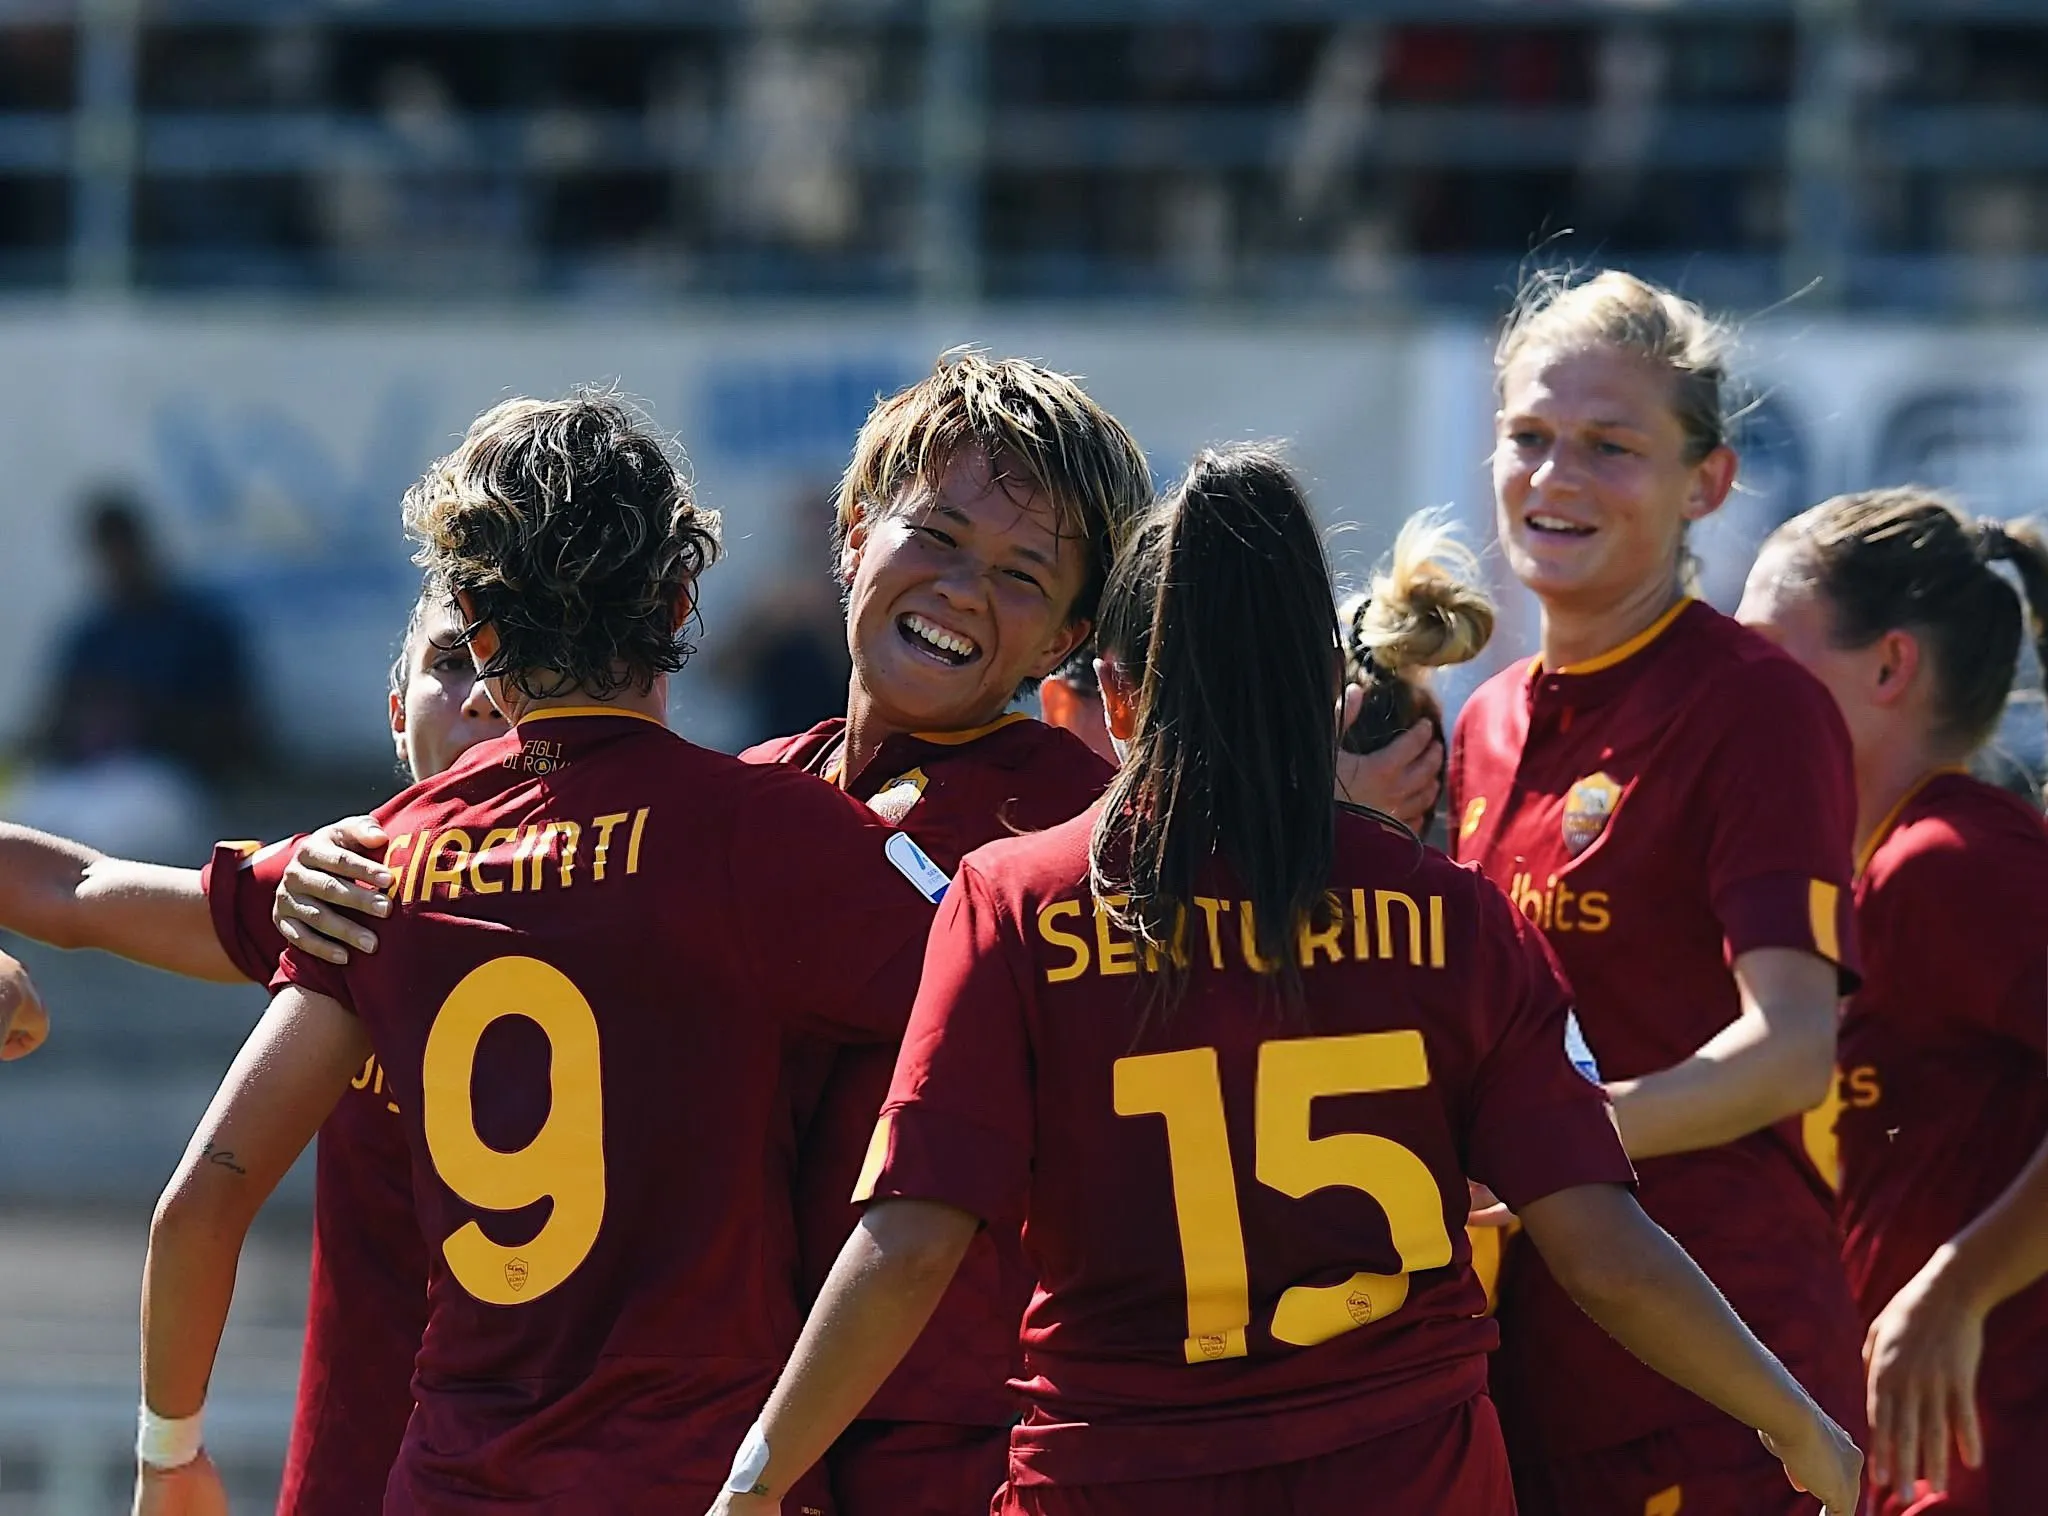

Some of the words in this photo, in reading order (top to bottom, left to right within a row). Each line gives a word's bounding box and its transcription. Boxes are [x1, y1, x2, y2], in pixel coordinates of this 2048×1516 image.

[502, 752, 520, 770] DI
[521, 739, 562, 759] FIGLI
[383, 806, 652, 906] GIACINTI
[423, 956, 606, 1305] 9
[1112, 1030, 1453, 1364] 15
